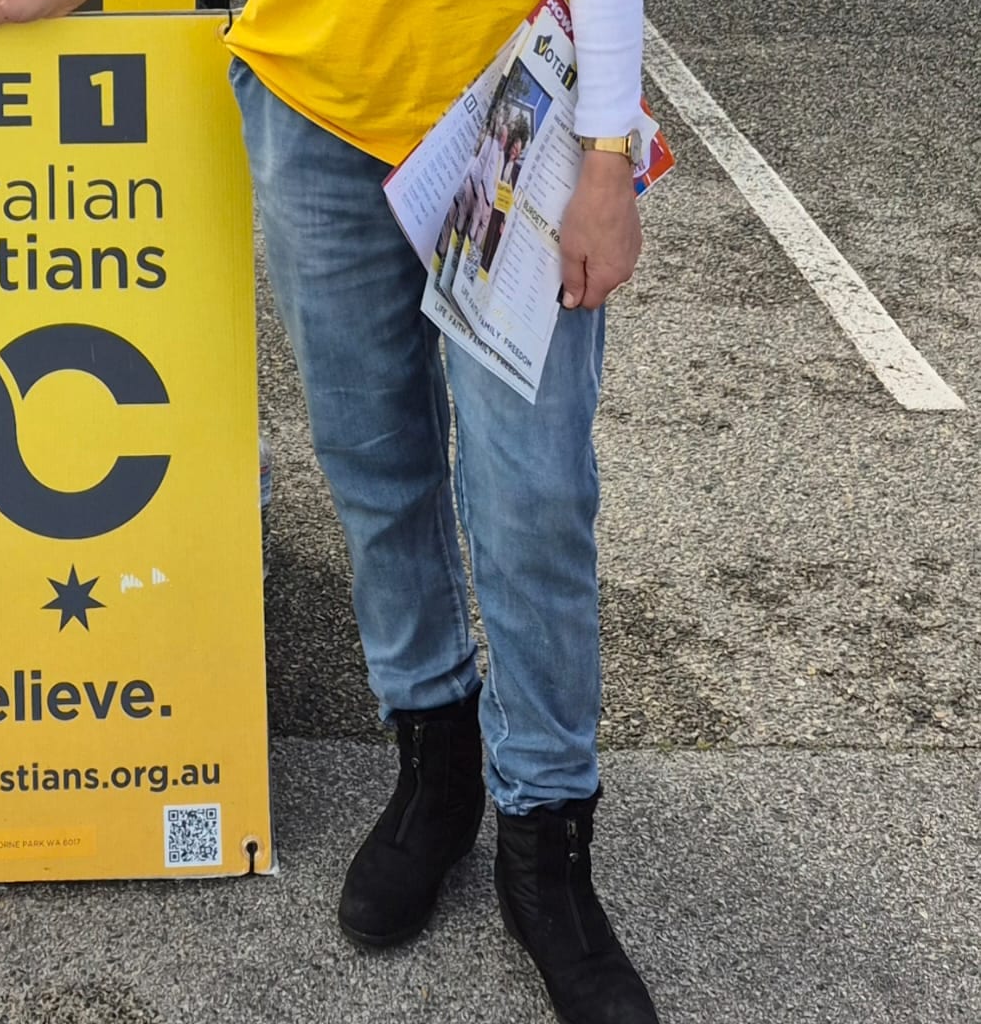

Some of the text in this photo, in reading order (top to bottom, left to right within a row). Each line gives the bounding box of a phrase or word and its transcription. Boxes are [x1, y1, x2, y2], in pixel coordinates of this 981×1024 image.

[538, 37, 566, 78] VOTE
[89, 71, 115, 127] 1
[434, 301, 448, 317] LIFE
[448, 314, 467, 336] FAITH
[503, 336, 532, 368] FREEDOM
[22, 840, 44, 848] PARK
[46, 839, 60, 847] WA
[63, 838, 81, 846] 6017
